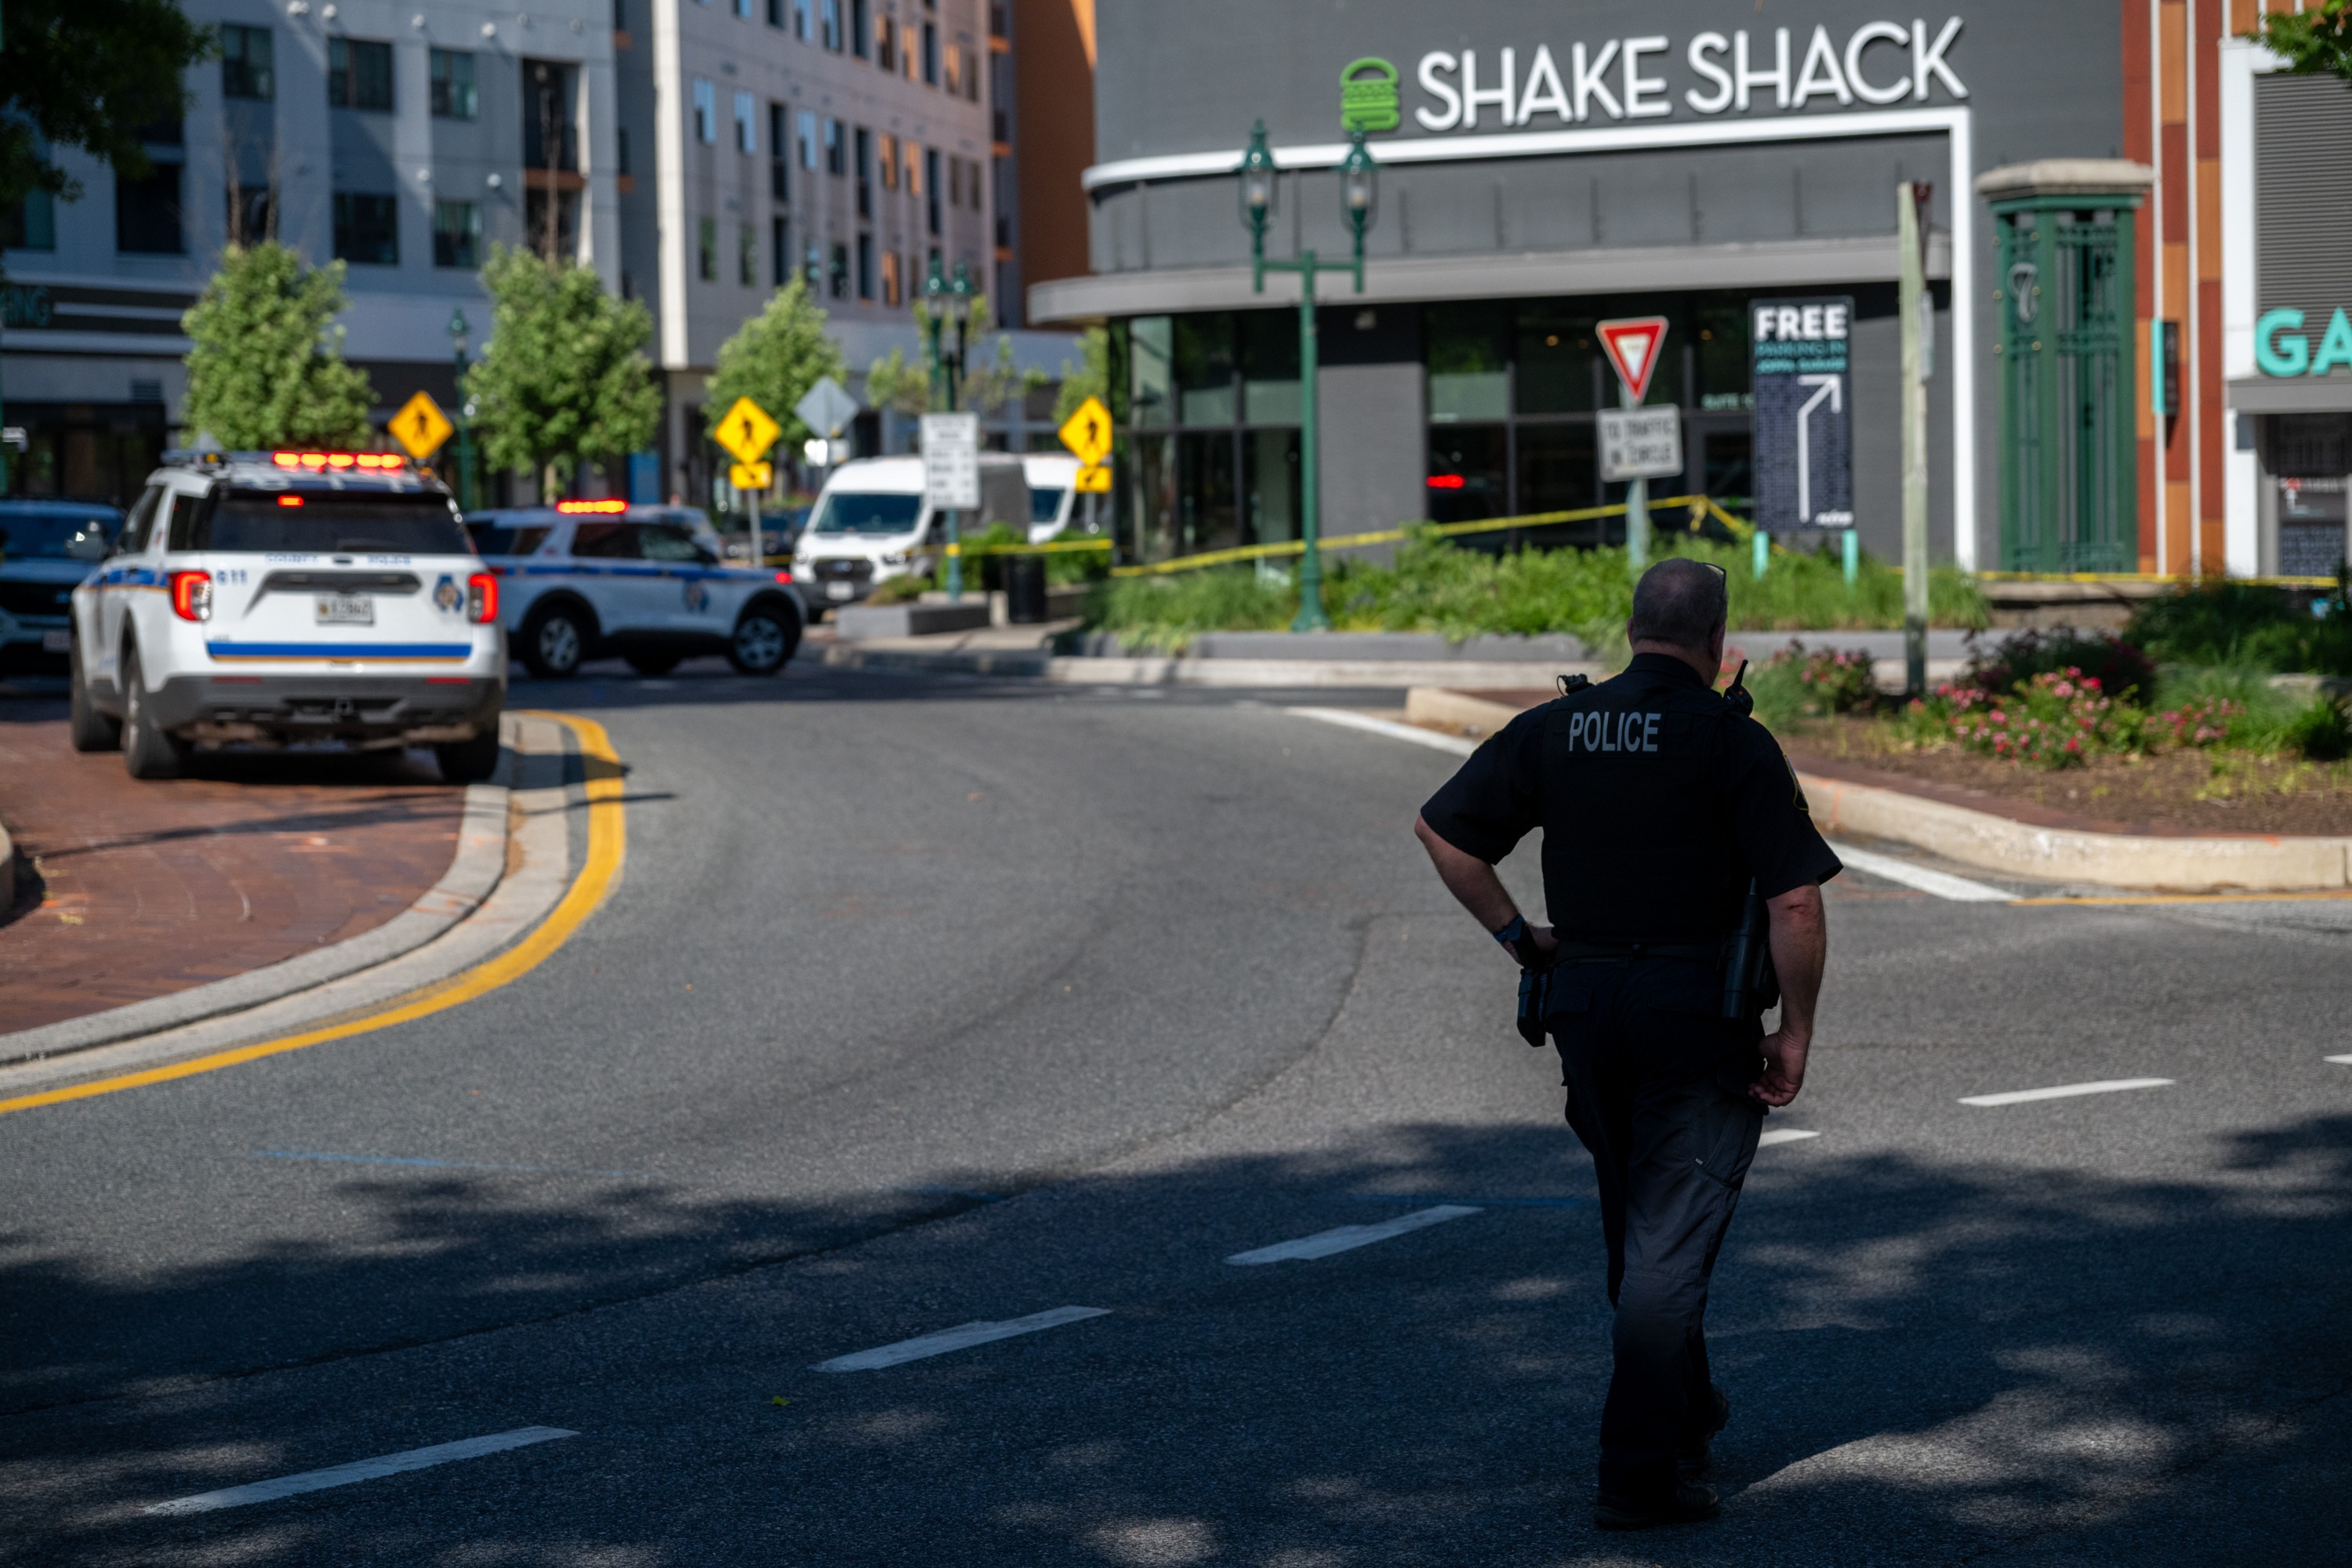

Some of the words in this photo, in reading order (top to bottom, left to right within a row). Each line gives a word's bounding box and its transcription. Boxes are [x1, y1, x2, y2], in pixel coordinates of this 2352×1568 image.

[1415, 35, 1672, 132] SHAKE
[1685, 16, 1969, 114] SHACK
[1755, 304, 1847, 341] FREE
[2256, 306, 2352, 377] GA
[216, 569, 247, 585] 611
[1569, 711, 1661, 752] POLICE
